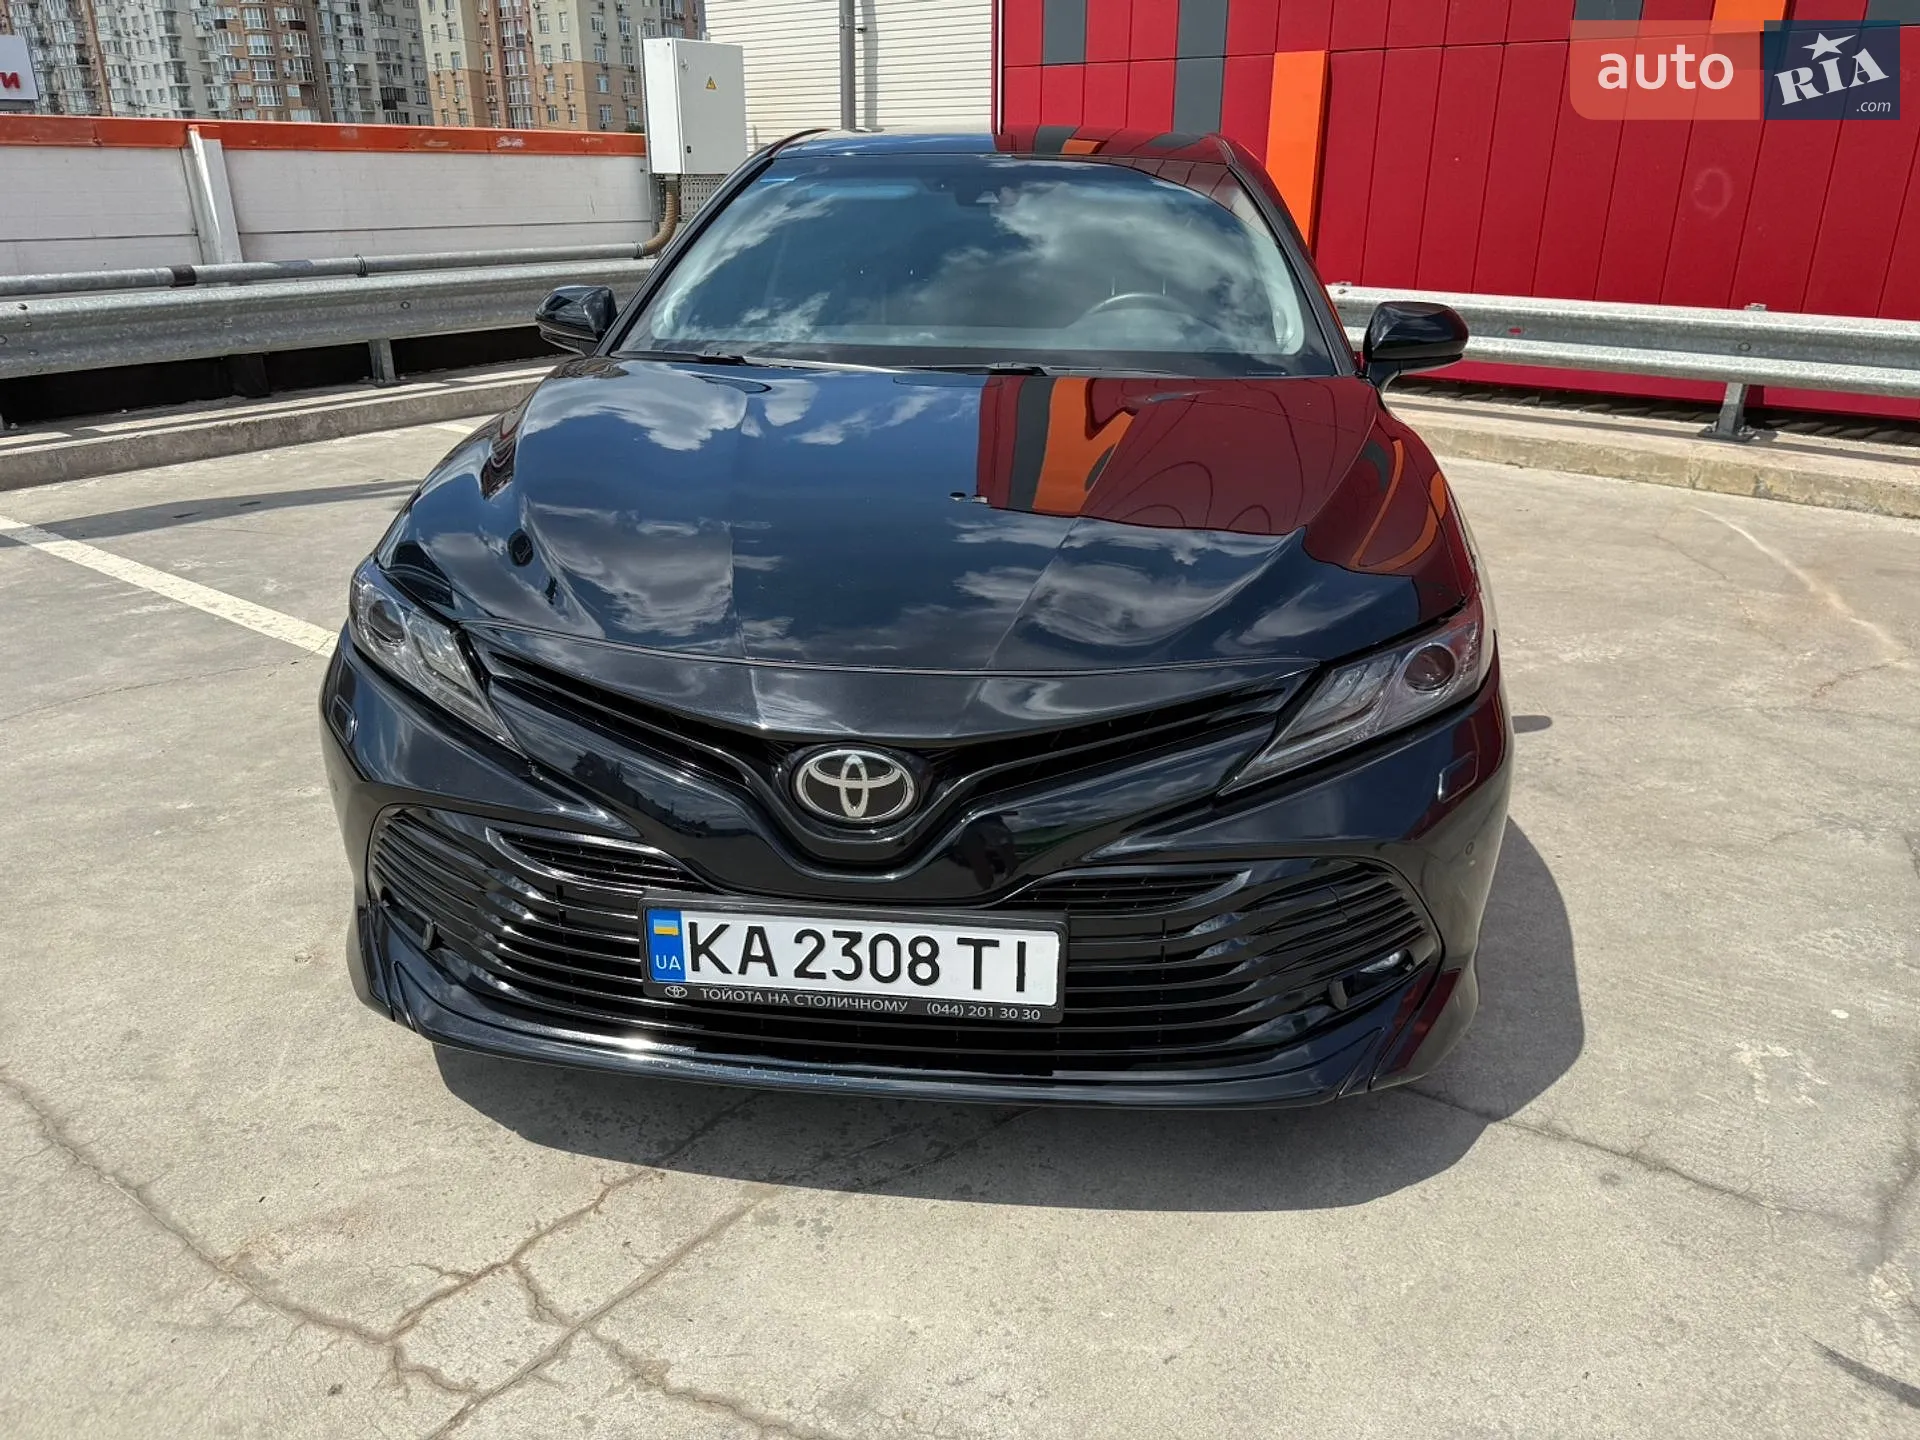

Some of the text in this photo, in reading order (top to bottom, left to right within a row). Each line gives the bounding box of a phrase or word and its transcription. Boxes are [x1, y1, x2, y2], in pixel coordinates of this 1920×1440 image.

[656, 954, 682, 971] UA
[687, 921, 1027, 993] KA 2308 TI
[700, 987, 908, 1012] ТОЙОТА НА СТОЛИЧНОМУ
[926, 1002, 1041, 1020] (044) 201 30 30
